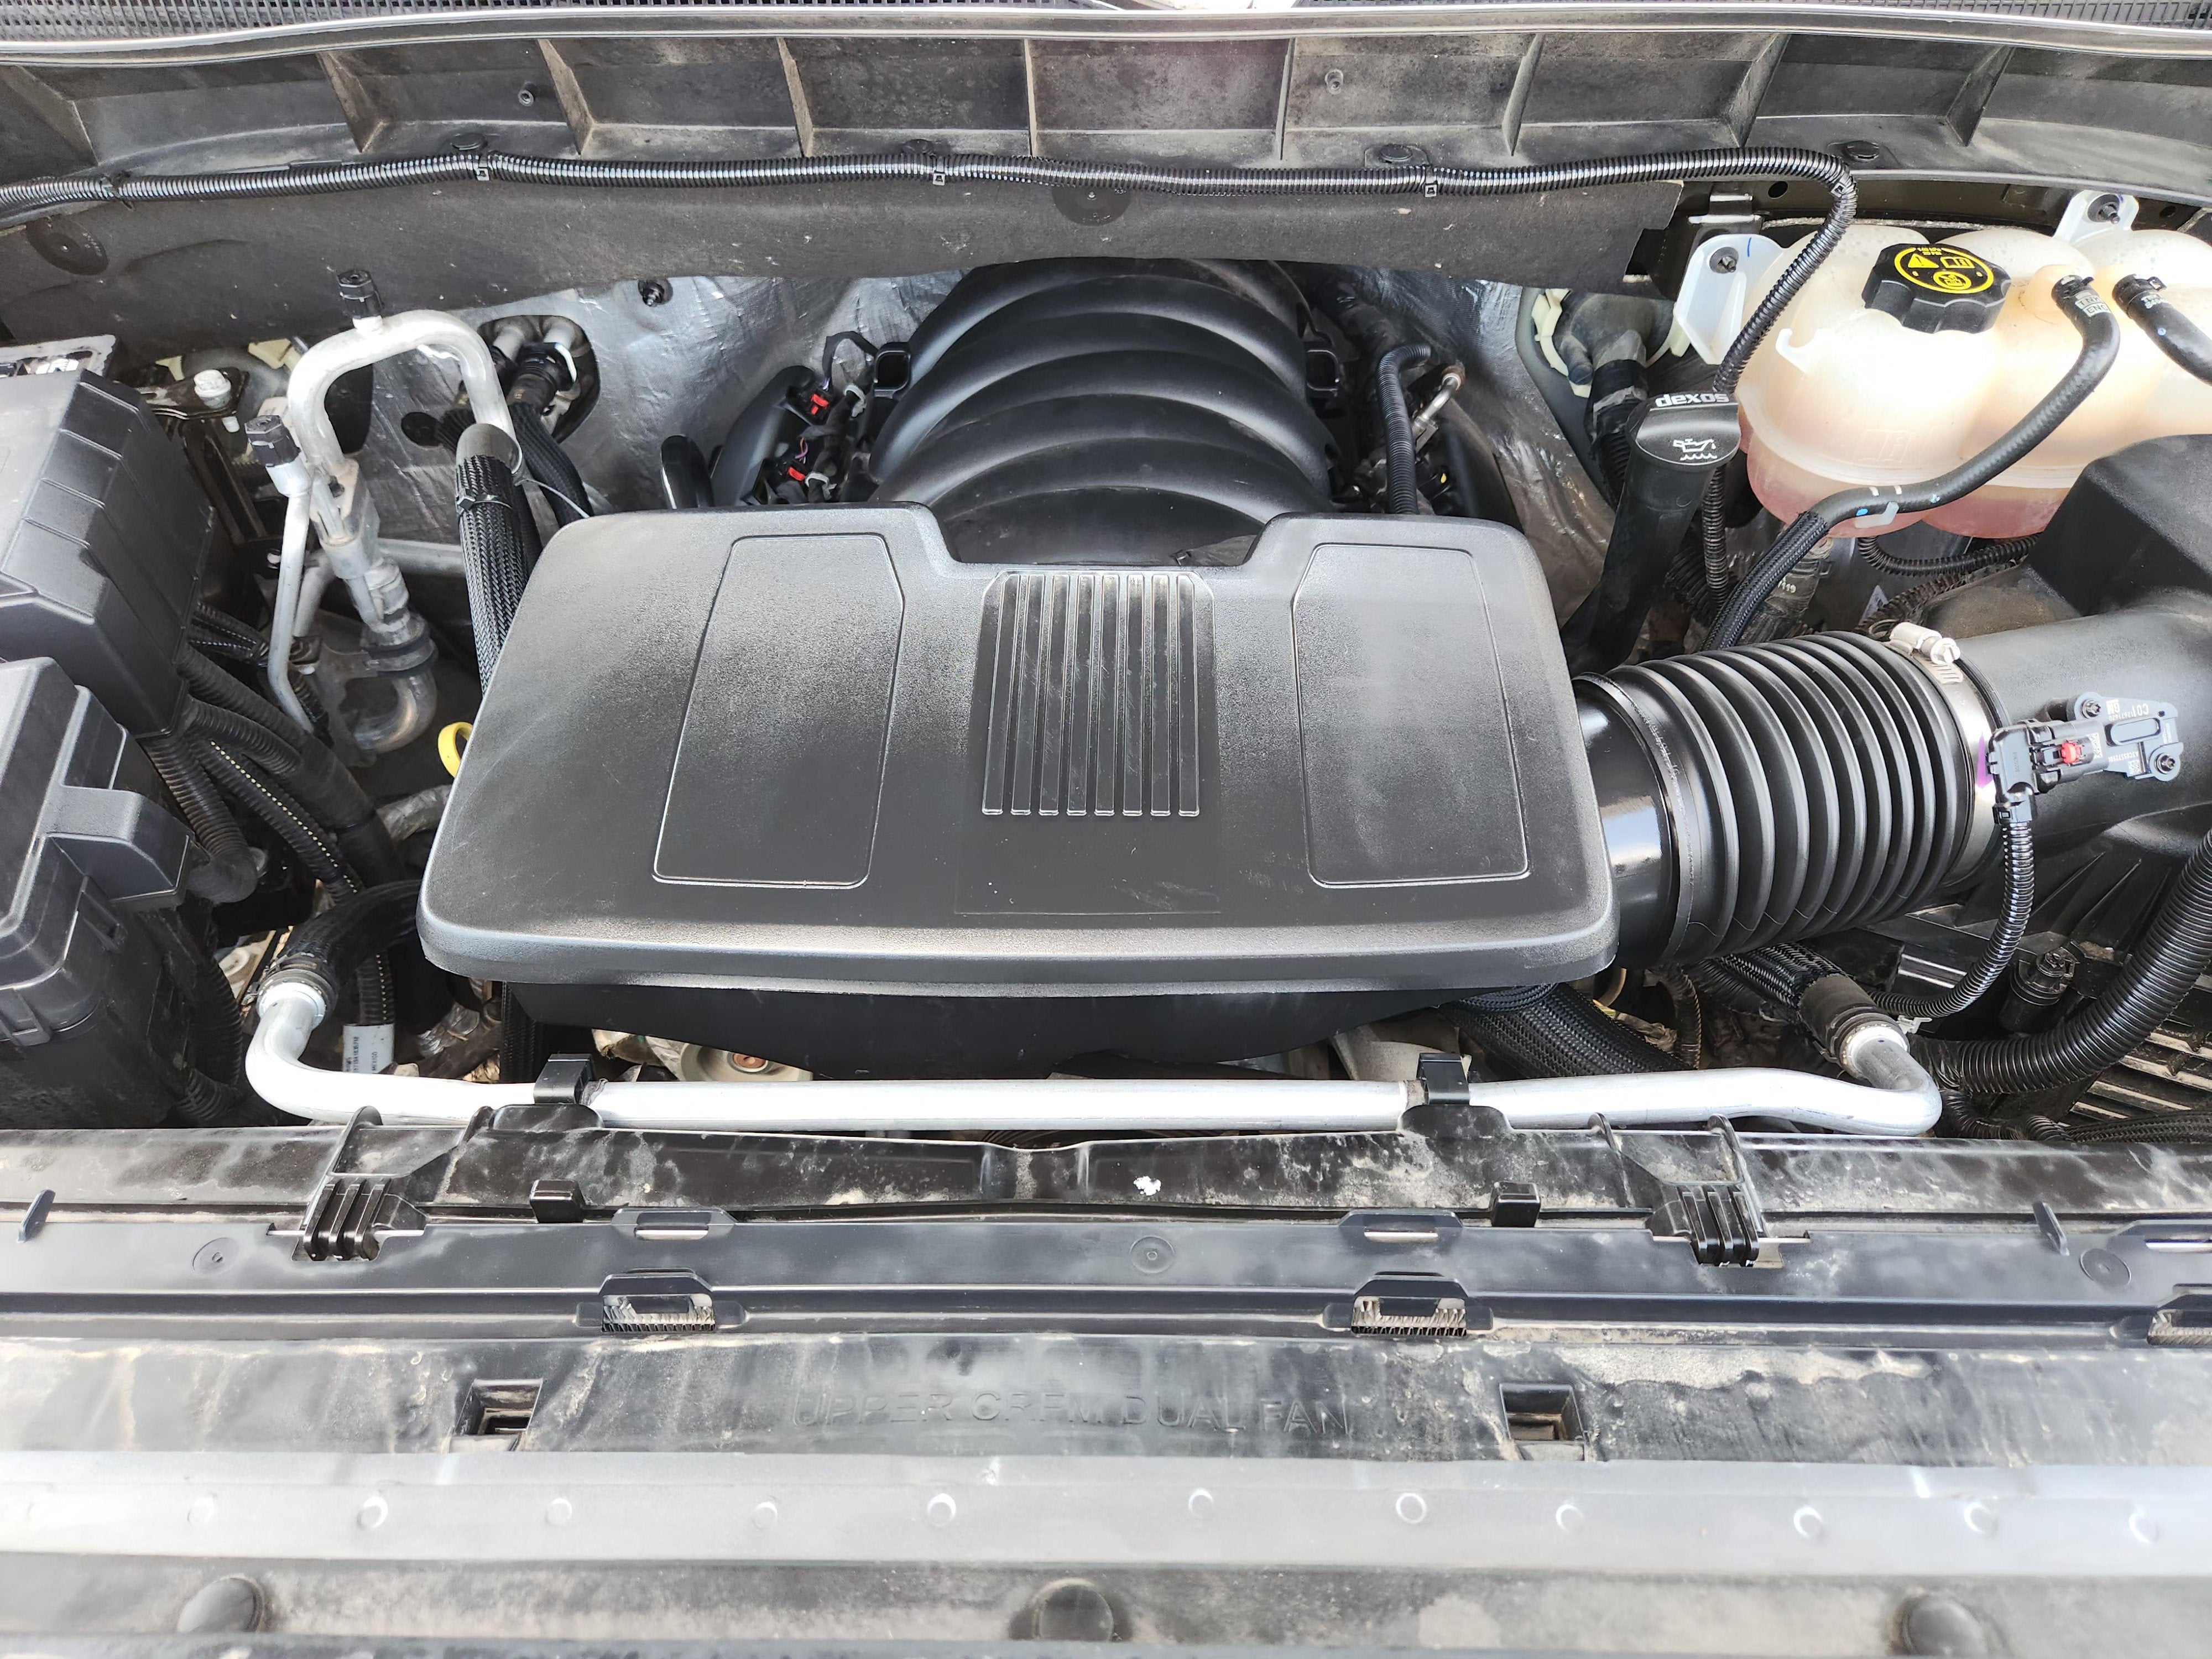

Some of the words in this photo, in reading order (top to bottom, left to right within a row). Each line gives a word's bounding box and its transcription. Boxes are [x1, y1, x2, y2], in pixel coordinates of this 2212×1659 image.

[1655, 393, 1729, 407] dexos
[2106, 700, 2120, 715] GM
[792, 1391, 954, 1427] UPPER
[1123, 1393, 1246, 1432] DUAL
[1258, 1395, 1352, 1436] FAN
